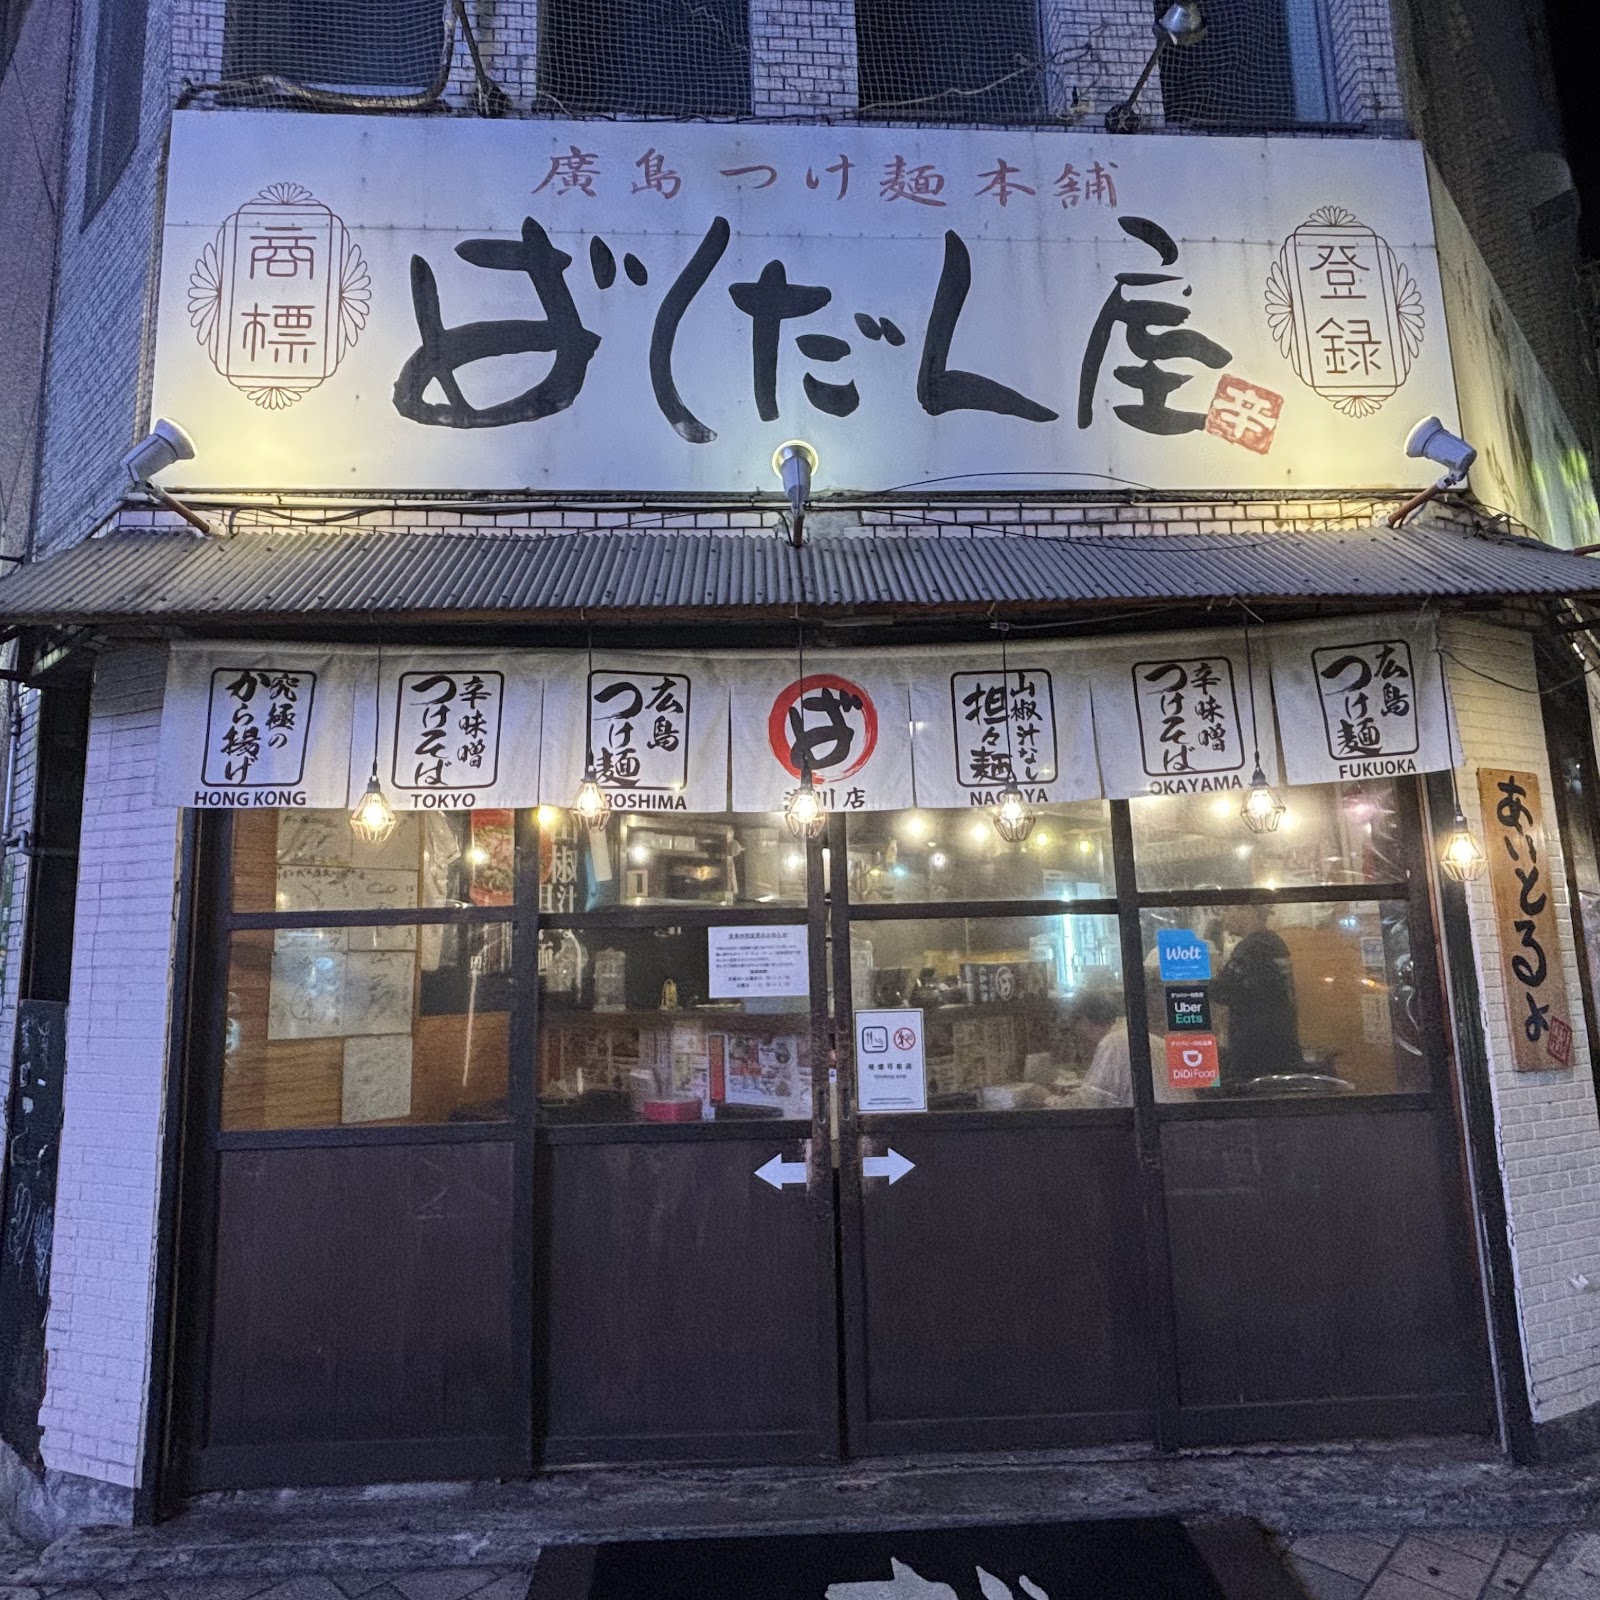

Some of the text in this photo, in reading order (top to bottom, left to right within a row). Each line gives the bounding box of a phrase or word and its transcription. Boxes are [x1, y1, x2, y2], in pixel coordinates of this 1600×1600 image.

[241, 227, 317, 365] 商標
[1308, 244, 1382, 376] 登録
[265, 672, 300, 749] 究極の
[457, 675, 492, 769] 辛味噌
[645, 676, 684, 752] 広島
[1144, 663, 1196, 773] つけそば
[1191, 662, 1226, 752] 辛味噌
[1320, 655, 1382, 755] つけ麺
[1374, 644, 1409, 717] 広島
[220, 671, 271, 785] から揚げ
[410, 674, 457, 787] つけそば
[593, 681, 643, 787] つけ麺
[788, 687, 862, 770] ば
[963, 683, 1013, 782] 担々麺
[1009, 671, 1043, 781] 山椒汁なし
[1339, 759, 1417, 779] FUKUOKA
[193, 791, 306, 806] HONG KONG
[411, 793, 476, 808] TOKYO
[783, 787, 866, 810] 川店
[1149, 775, 1243, 796] OKAYAMA
[1496, 775, 1550, 1042] あいとるよ
[1165, 946, 1202, 960] Wolt
[1174, 1002, 1202, 1013] Uber
[1175, 1013, 1203, 1024] Eats
